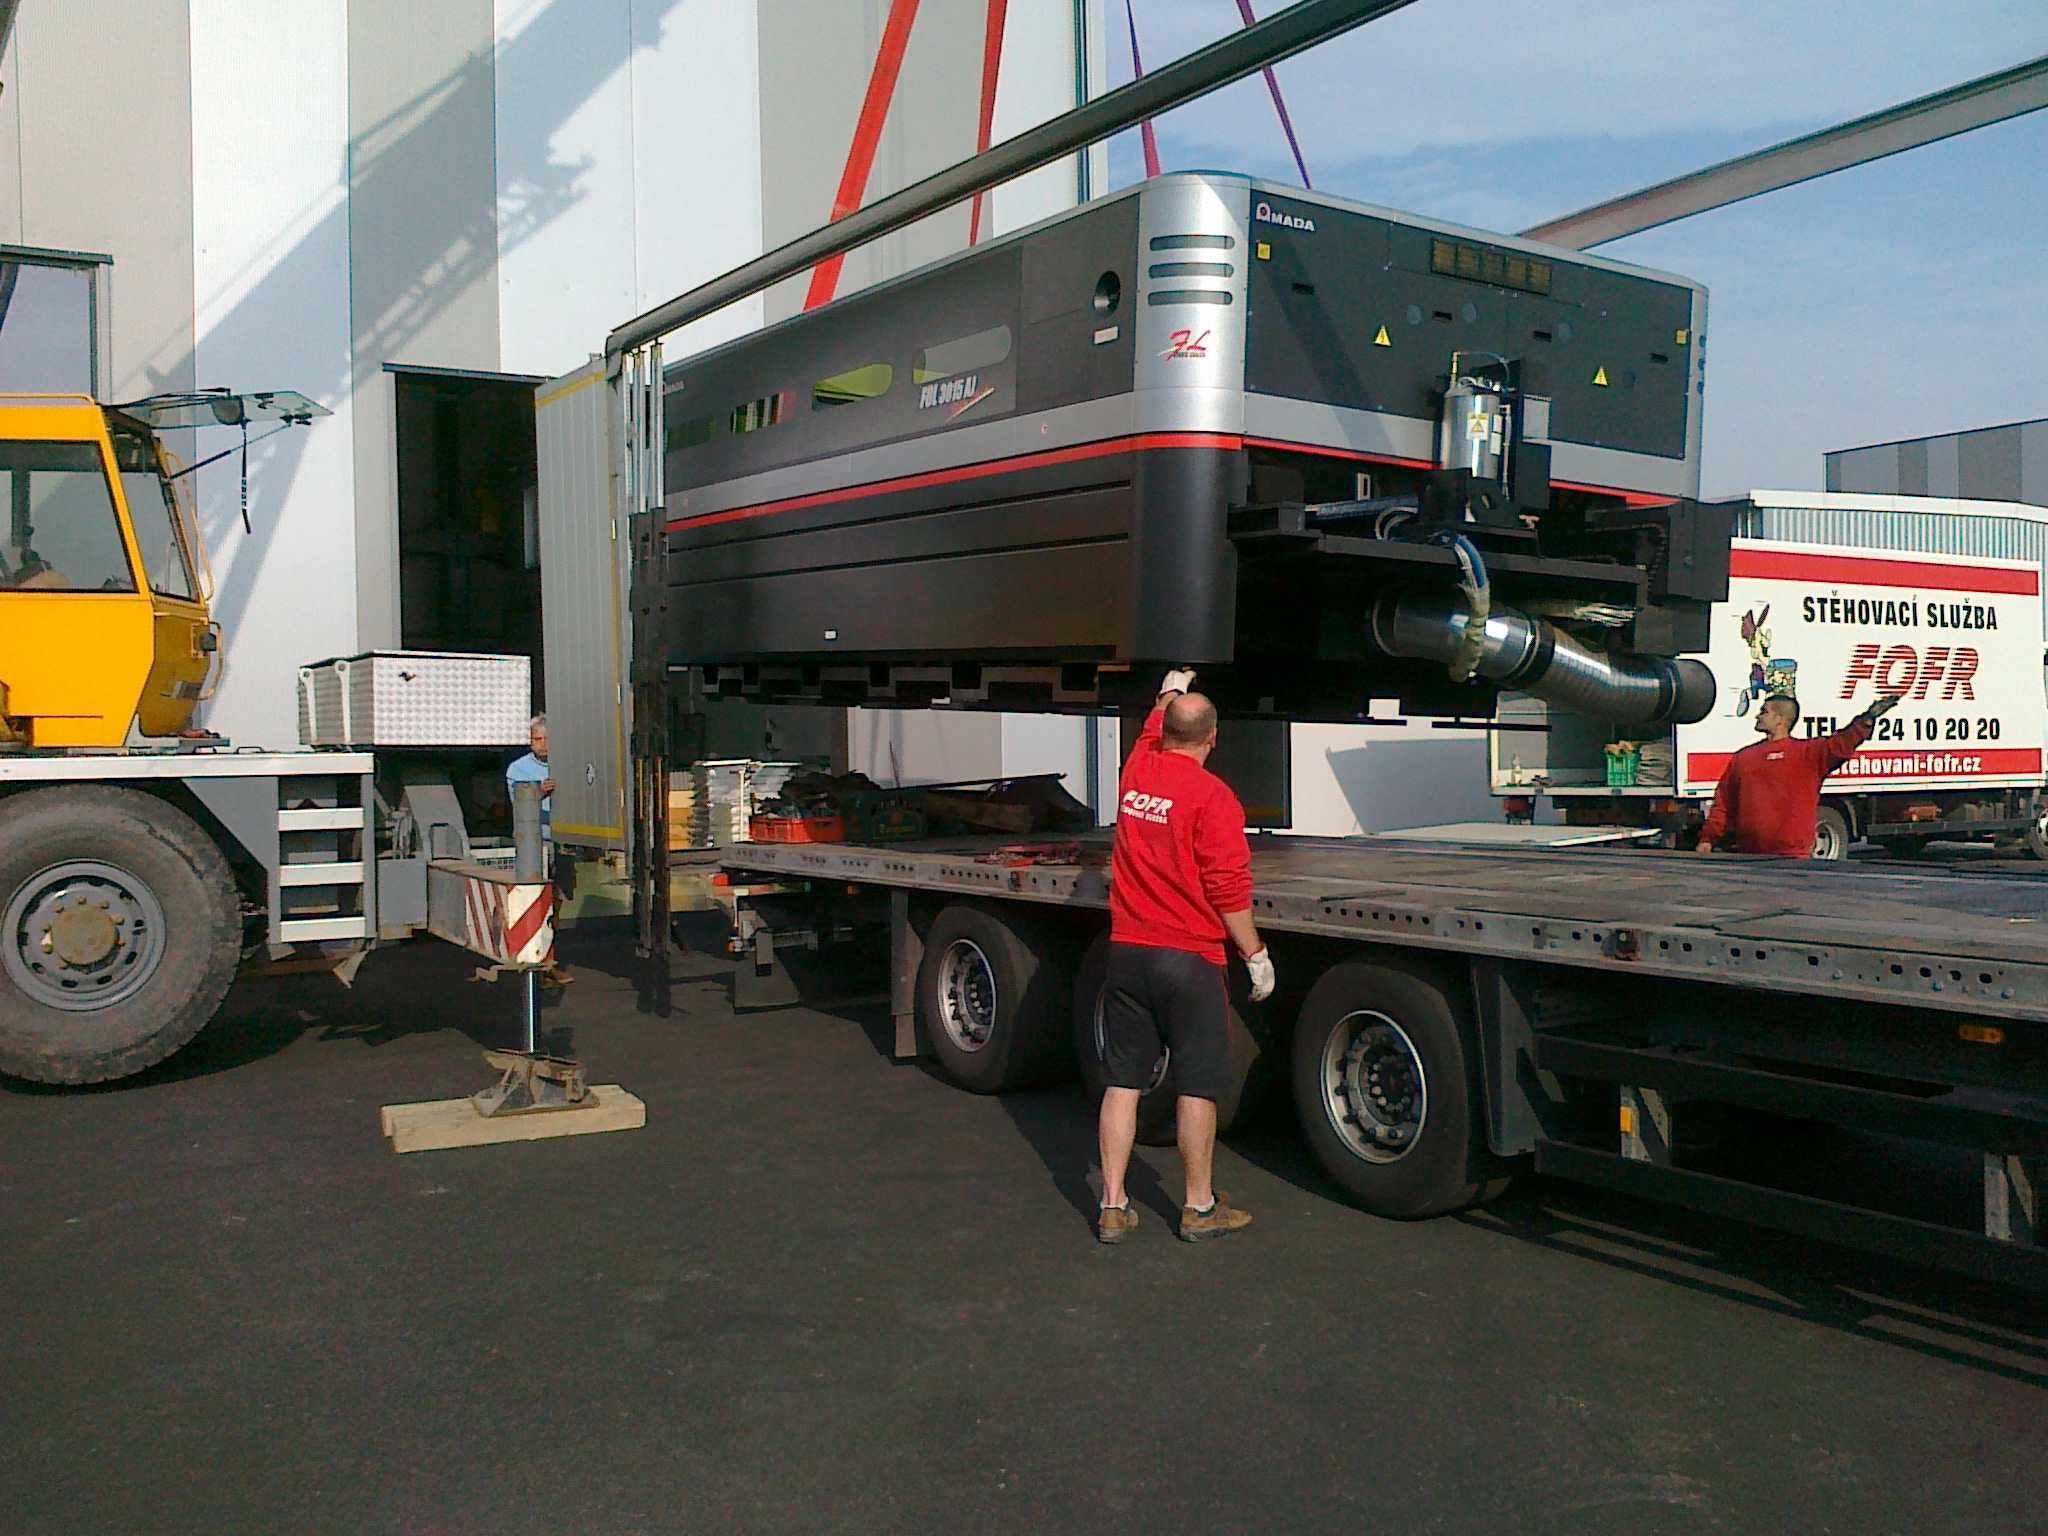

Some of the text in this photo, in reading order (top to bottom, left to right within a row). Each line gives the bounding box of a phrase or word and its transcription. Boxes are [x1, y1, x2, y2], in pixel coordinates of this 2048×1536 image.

[1256, 203, 1315, 232] AMADA
[938, 379, 965, 404] 3015
[1803, 590, 1998, 630] STĚHOVACÍ SLUŽBA
[1836, 644, 1979, 700] FOFR
[1866, 718, 1905, 741] 24
[1914, 718, 1938, 741] 10
[1945, 718, 1969, 741] 20
[1977, 718, 2001, 741] 20
[1123, 789, 1173, 817] FOFR
